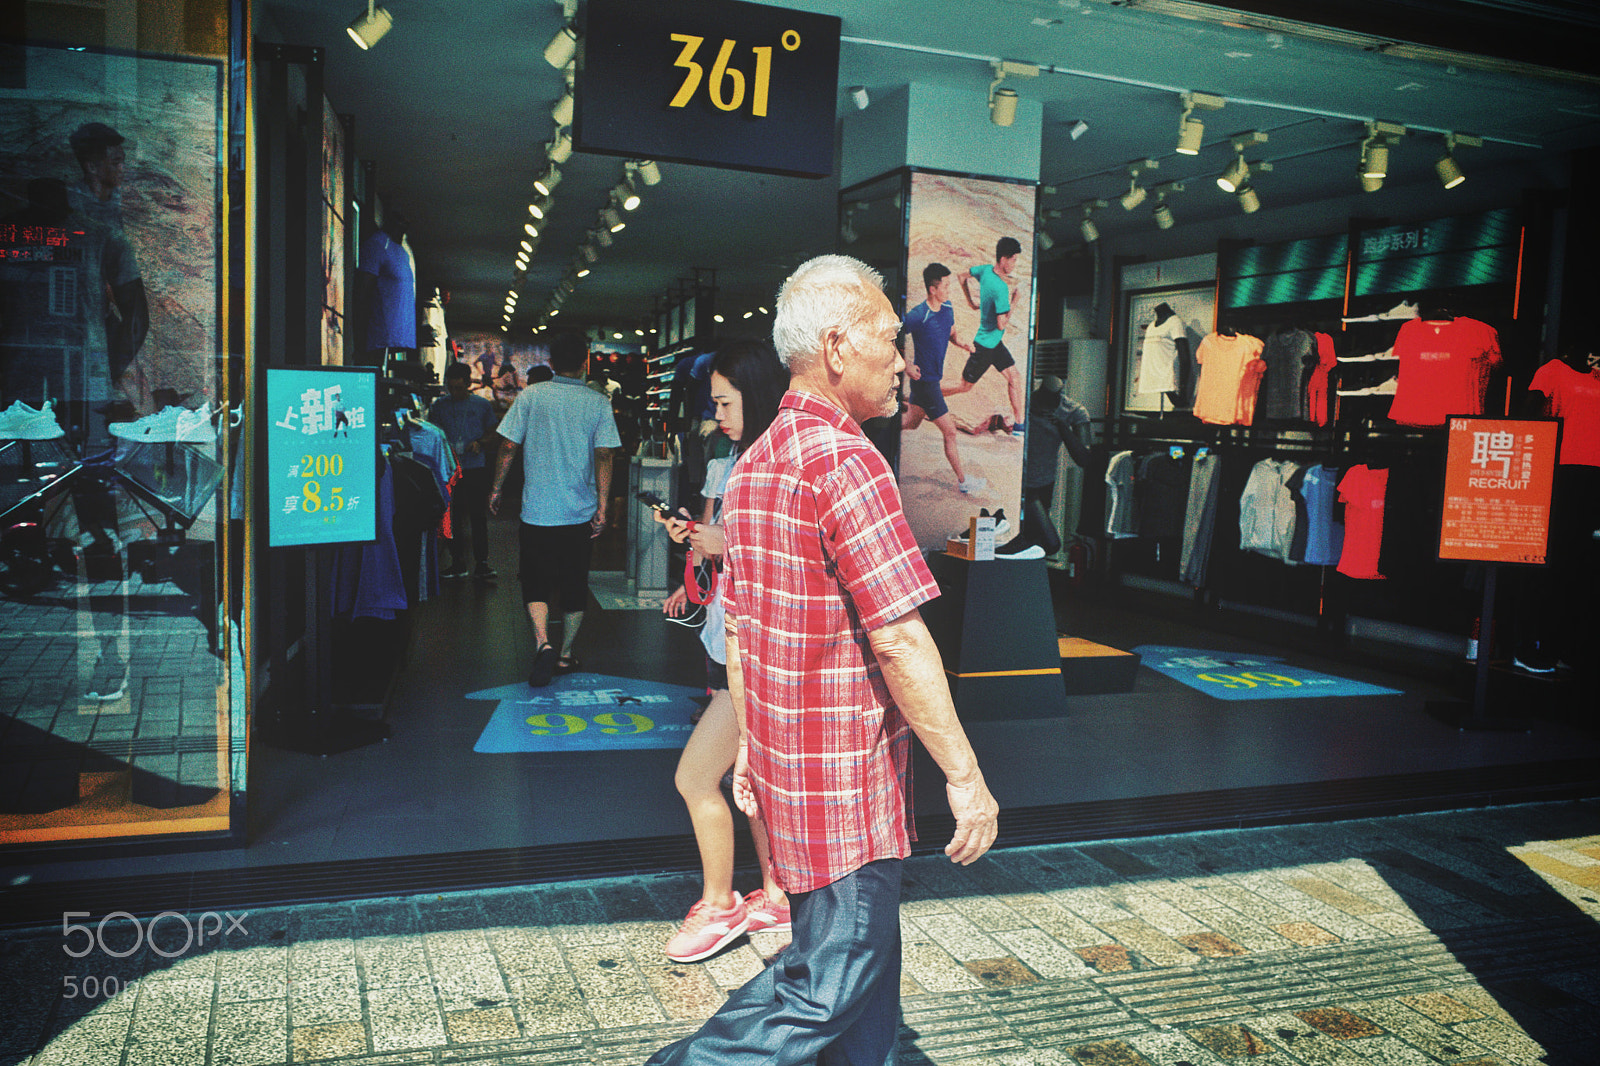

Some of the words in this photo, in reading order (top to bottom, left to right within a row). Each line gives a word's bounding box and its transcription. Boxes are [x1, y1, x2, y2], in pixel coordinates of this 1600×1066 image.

[669, 29, 801, 117] 361°
[1471, 430, 1514, 479] 聘
[1468, 477, 1531, 490] RECRUIT
[525, 712, 654, 736] 99
